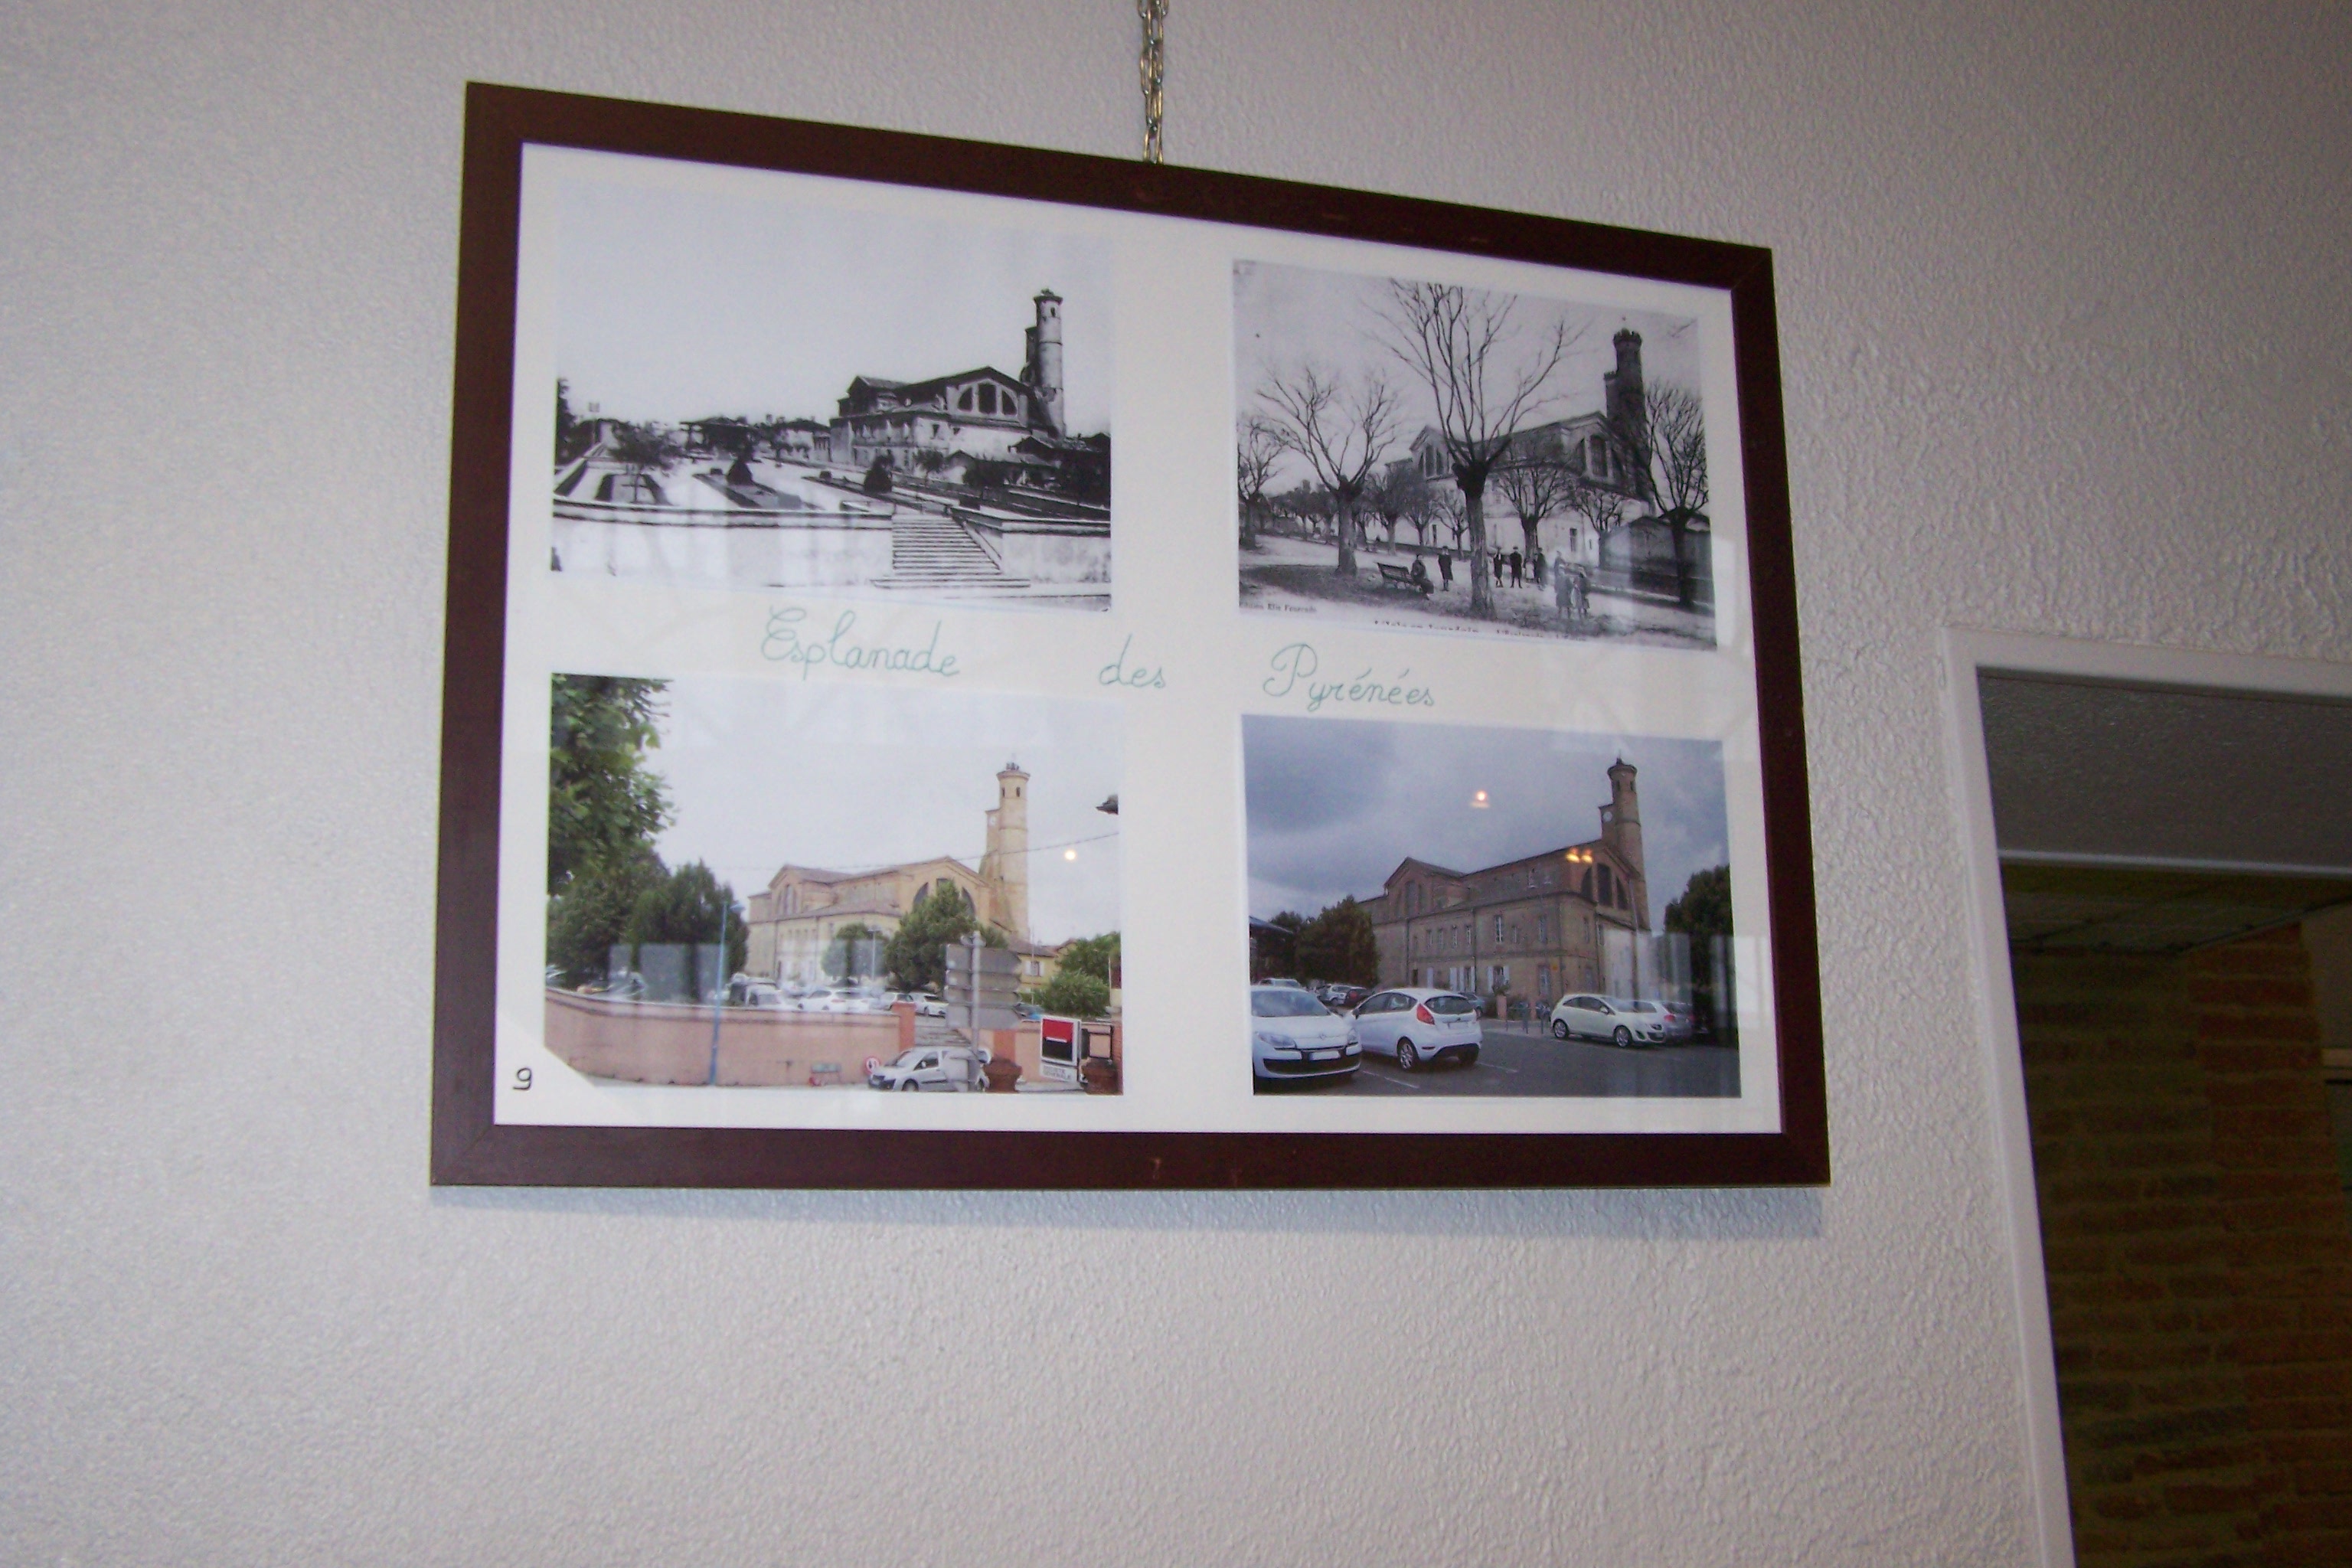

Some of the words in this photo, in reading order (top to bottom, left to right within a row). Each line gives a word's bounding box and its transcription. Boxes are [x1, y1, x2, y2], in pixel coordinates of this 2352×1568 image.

[761, 605, 960, 681] Esplanade
[1099, 633, 1166, 688] des
[1263, 644, 1435, 713] Pyrénées
[512, 1067, 532, 1091] 9
